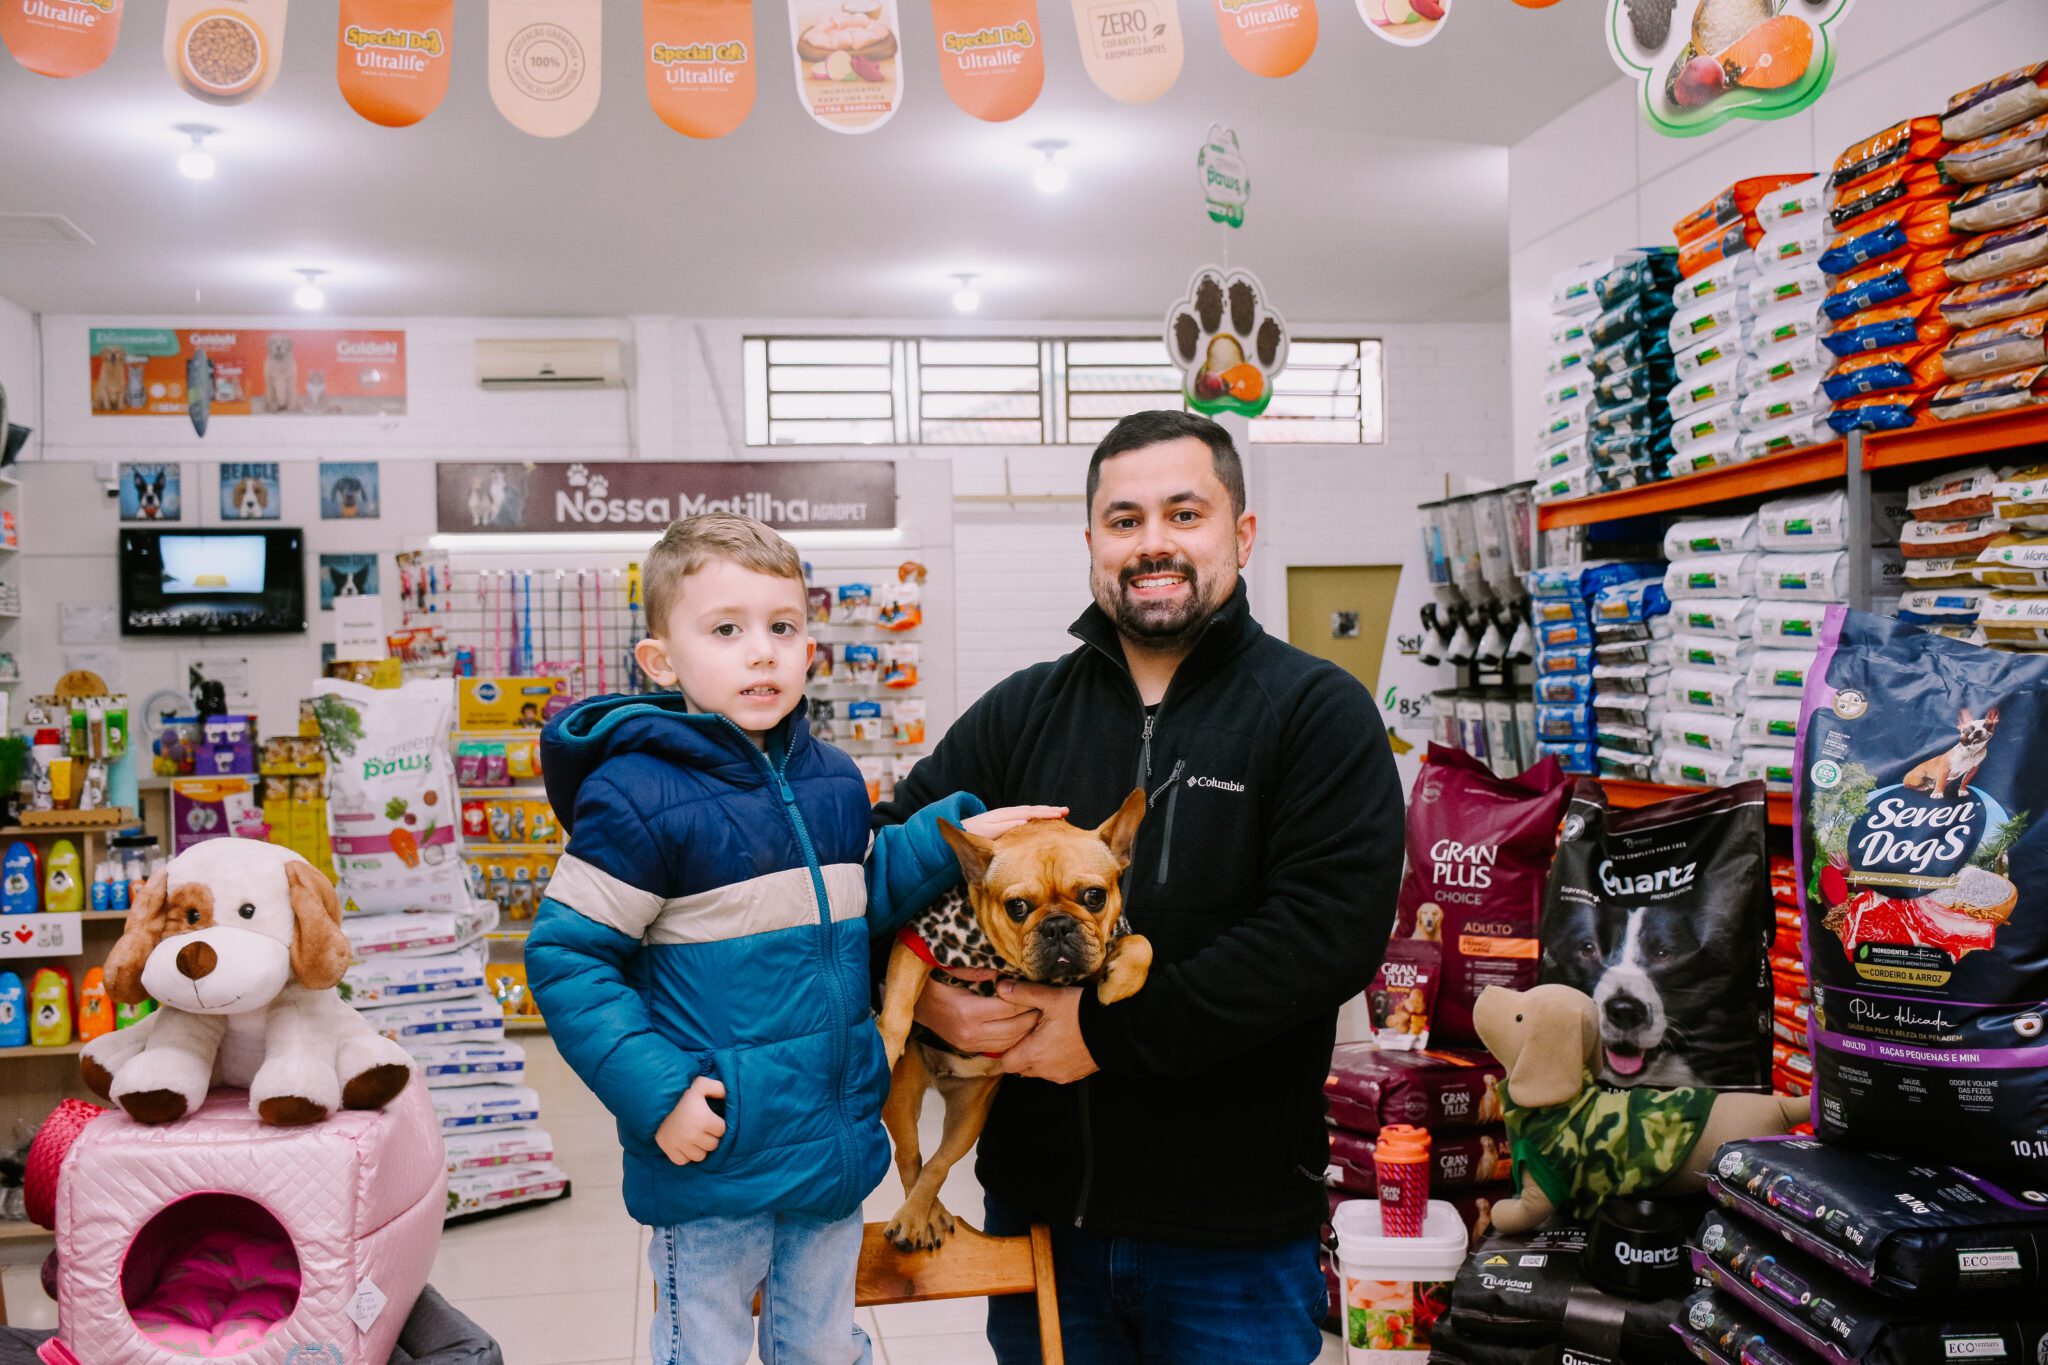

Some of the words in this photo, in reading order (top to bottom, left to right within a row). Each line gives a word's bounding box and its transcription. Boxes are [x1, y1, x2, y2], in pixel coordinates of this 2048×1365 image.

[23, 1, 95, 27] Ultralife
[1236, 4, 1300, 29] Ultralife
[1097, 9, 1147, 37] ZERO
[347, 27, 405, 48] Special
[409, 30, 442, 54] Dog
[946, 29, 1001, 50] Special
[1004, 23, 1034, 45] Dog
[654, 46, 713, 64] Special
[716, 43, 744, 62] Cat
[957, 50, 1023, 70] Ultralife
[355, 52, 425, 72] Ultralife
[530, 56, 561, 68] 100%
[666, 66, 735, 84] Ultralife
[1207, 165, 1241, 193] paws
[556, 490, 670, 523] Nossa
[679, 491, 810, 523] Matilha
[812, 503, 868, 521] AGROPET
[363, 752, 434, 780] paws
[1198, 776, 1245, 792] Columbia
[1867, 797, 1976, 829] Seven
[1430, 839, 1499, 865] GRAN
[1433, 863, 1492, 888] PLUS
[1599, 860, 1697, 896] Quartz
[1846, 874, 1902, 887] premium
[1908, 873, 1963, 892] especial
[1434, 890, 1483, 905] CHOICE
[1464, 922, 1512, 935] ADULTO
[1872, 947, 1909, 956] INGREDIENTES
[1381, 962, 1417, 976] GRAN
[1870, 968, 1906, 979] CORDEIRO
[1908, 972, 1914, 980] &
[1915, 974, 1942, 982] ARROZ
[1385, 975, 1415, 987] PLUS
[1849, 997, 1889, 1022] Pele
[1894, 1005, 1959, 1031] delicada
[1895, 1030, 1917, 1039] BELEZA
[1842, 1040, 1866, 1051] ADULTO
[1880, 1046, 1905, 1058] RAÇAS
[1906, 1051, 1949, 1062] PEQUENAS
[1952, 1054, 1958, 1062] E
[1960, 1054, 1980, 1062] MINI
[1949, 1079, 1965, 1087] ODOR
[1971, 1087, 1991, 1095] FEZES
[1441, 1091, 1470, 1105] GRAN
[1824, 1098, 1841, 1112] LIVRE
[1958, 1094, 1994, 1102] REDUZIDOS
[1444, 1104, 1469, 1115] PLUS
[1440, 1154, 1468, 1167] GRAN
[1443, 1167, 1467, 1179] PLUS
[1381, 1184, 1401, 1194] GRAN
[1383, 1193, 1400, 1201] PLUS
[1845, 1225, 1864, 1246] 10,1kg
[1615, 1241, 1679, 1265] Quartz
[1963, 1256, 1989, 1267] ECO
[1831, 1316, 1851, 1338] 10,1kg
[1949, 1342, 1975, 1354] ECO
